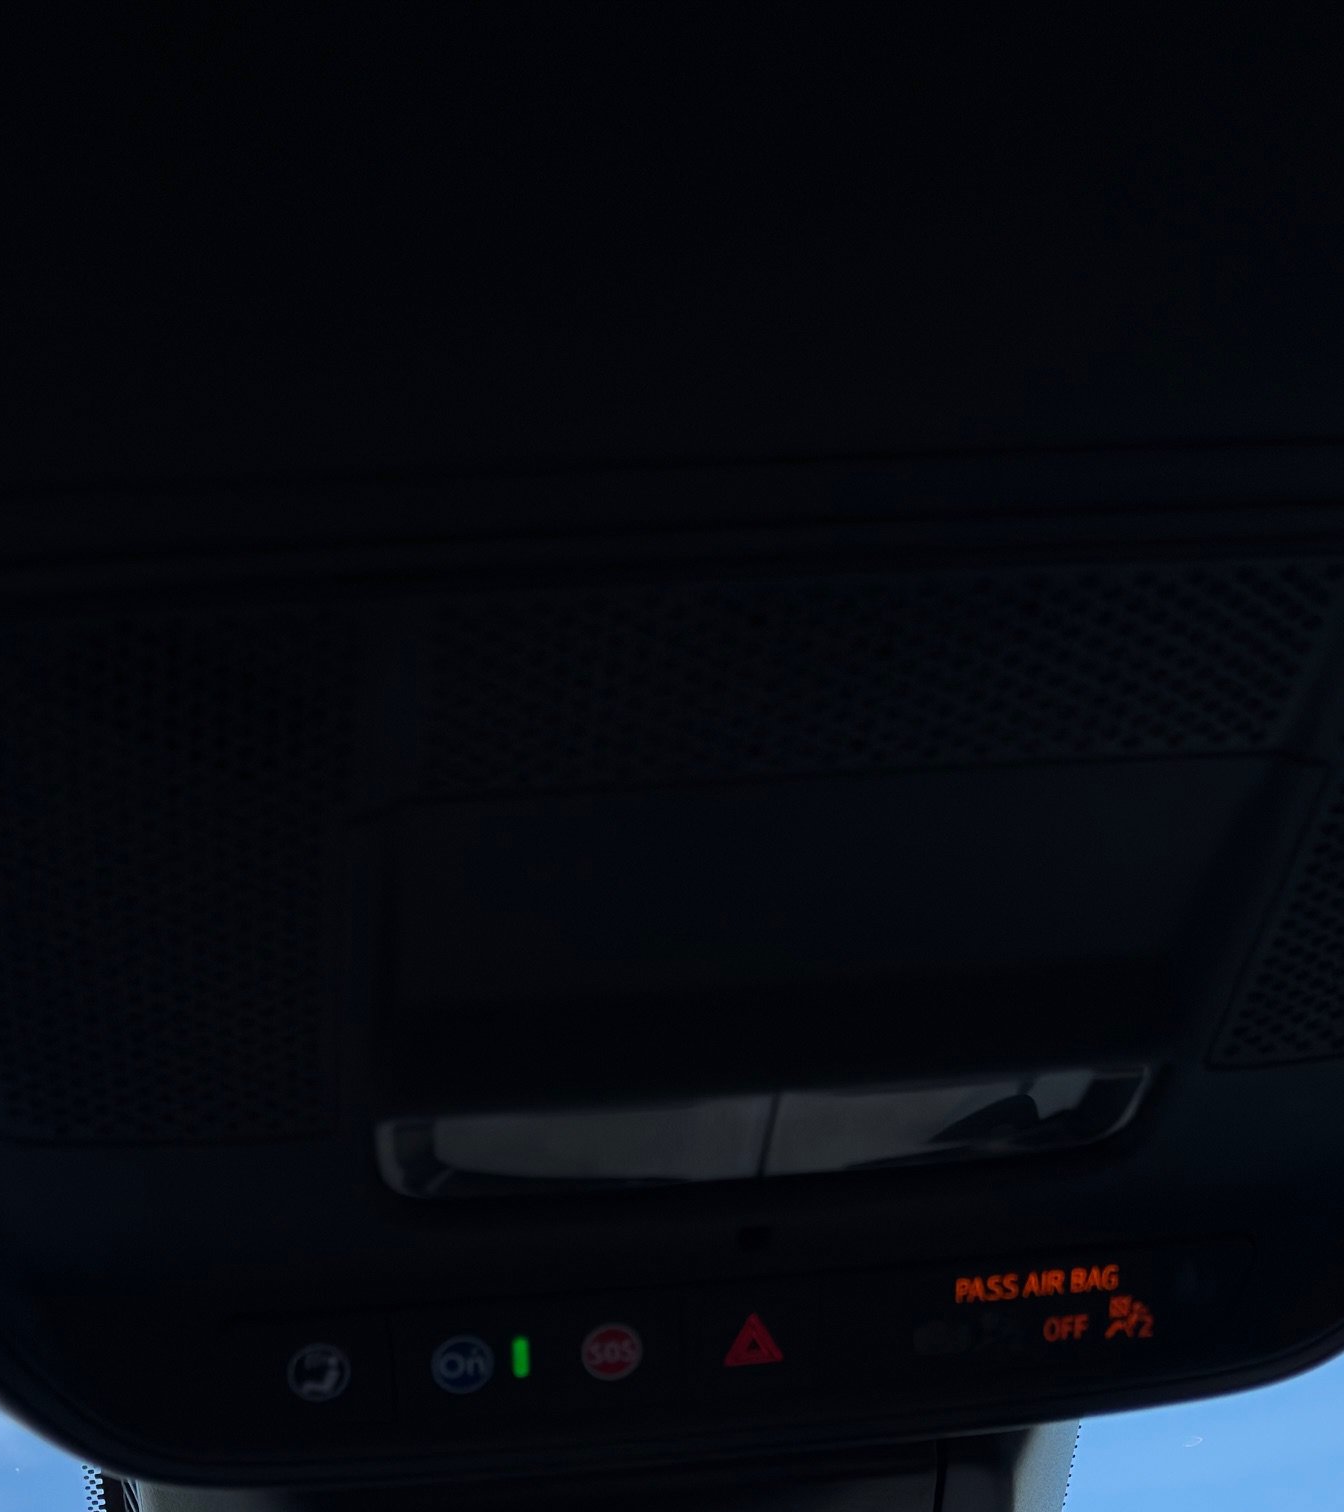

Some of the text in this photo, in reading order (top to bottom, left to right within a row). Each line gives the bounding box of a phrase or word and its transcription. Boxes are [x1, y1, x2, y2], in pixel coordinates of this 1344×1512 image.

[955, 1263, 1119, 1304] PASS AIR BAG
[1042, 1313, 1089, 1343] OFF
[588, 1339, 637, 1366] SOS
